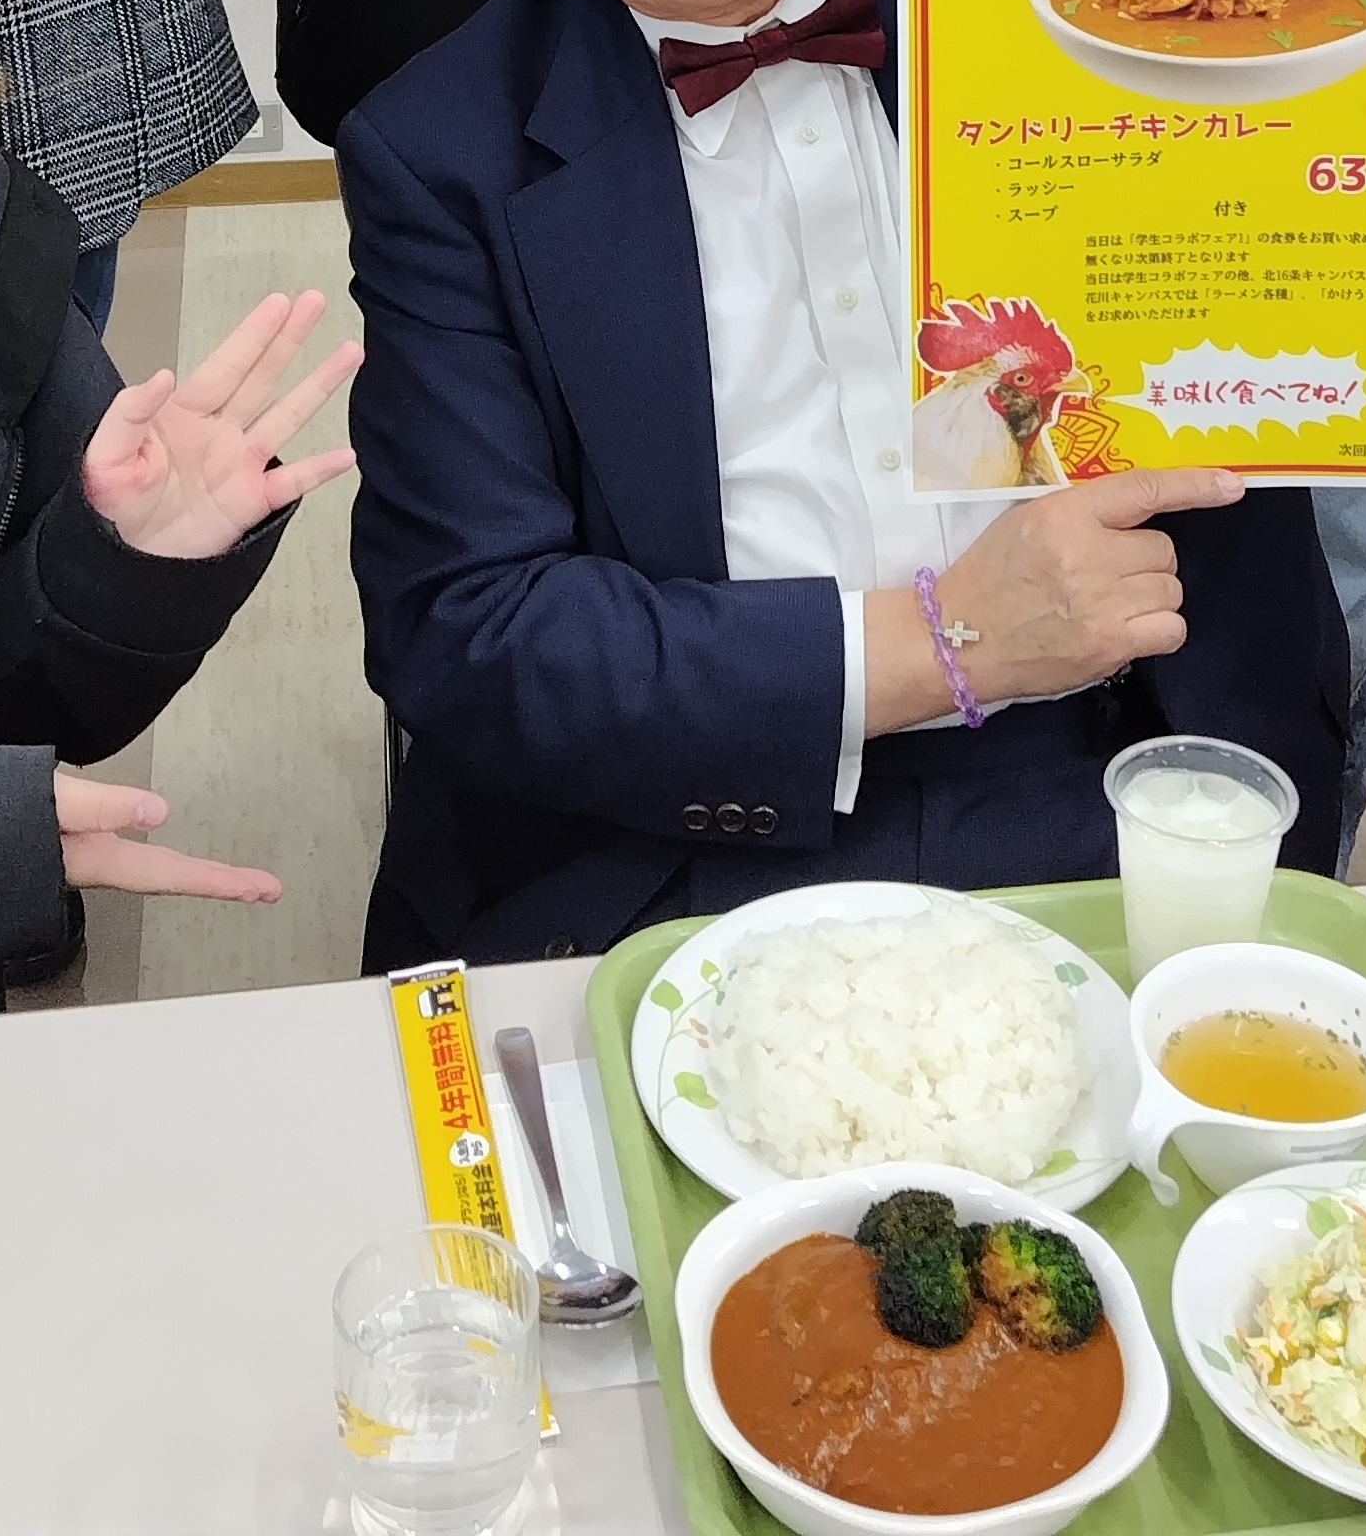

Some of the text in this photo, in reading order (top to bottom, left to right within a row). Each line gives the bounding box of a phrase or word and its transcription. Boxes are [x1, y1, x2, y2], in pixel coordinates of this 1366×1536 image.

[956, 113, 1293, 146] タンドリーチキンカレー
[1214, 200, 1248, 217] 付き
[426, 1021, 473, 1129] 4年間無料
